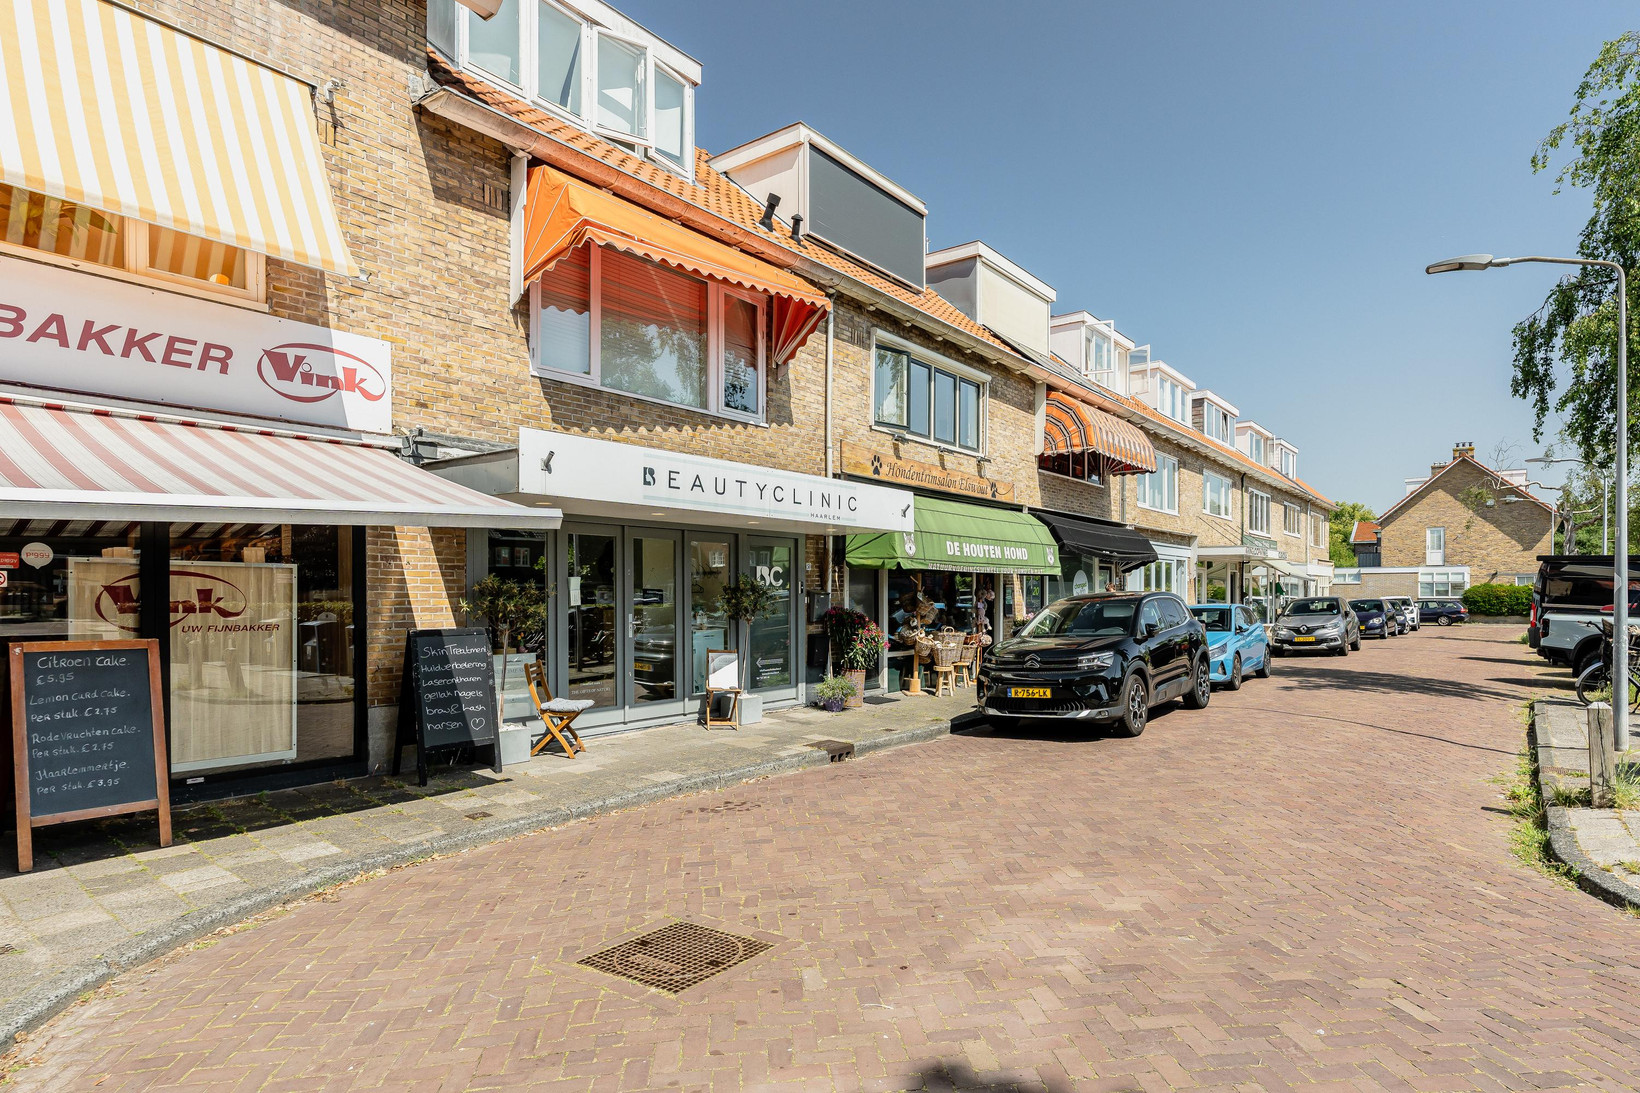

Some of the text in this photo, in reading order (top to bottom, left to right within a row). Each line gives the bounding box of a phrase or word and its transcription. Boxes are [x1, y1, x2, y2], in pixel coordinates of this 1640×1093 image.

[0, 304, 234, 375] BAKKER
[262, 348, 376, 401] Vink
[886, 462, 957, 489] Hondentrimsalon
[810, 512, 841, 521] HAARLEM
[946, 540, 1029, 560] DE HOUTEN HOND
[101, 585, 240, 618] Vnk
[181, 623, 280, 633] UW FIJNBAKKER
[420, 661, 487, 673] Huidverbetering
[454, 690, 483, 700] nagels
[1014, 689, 1048, 697] R-756-LK
[29, 694, 69, 706] Lemon
